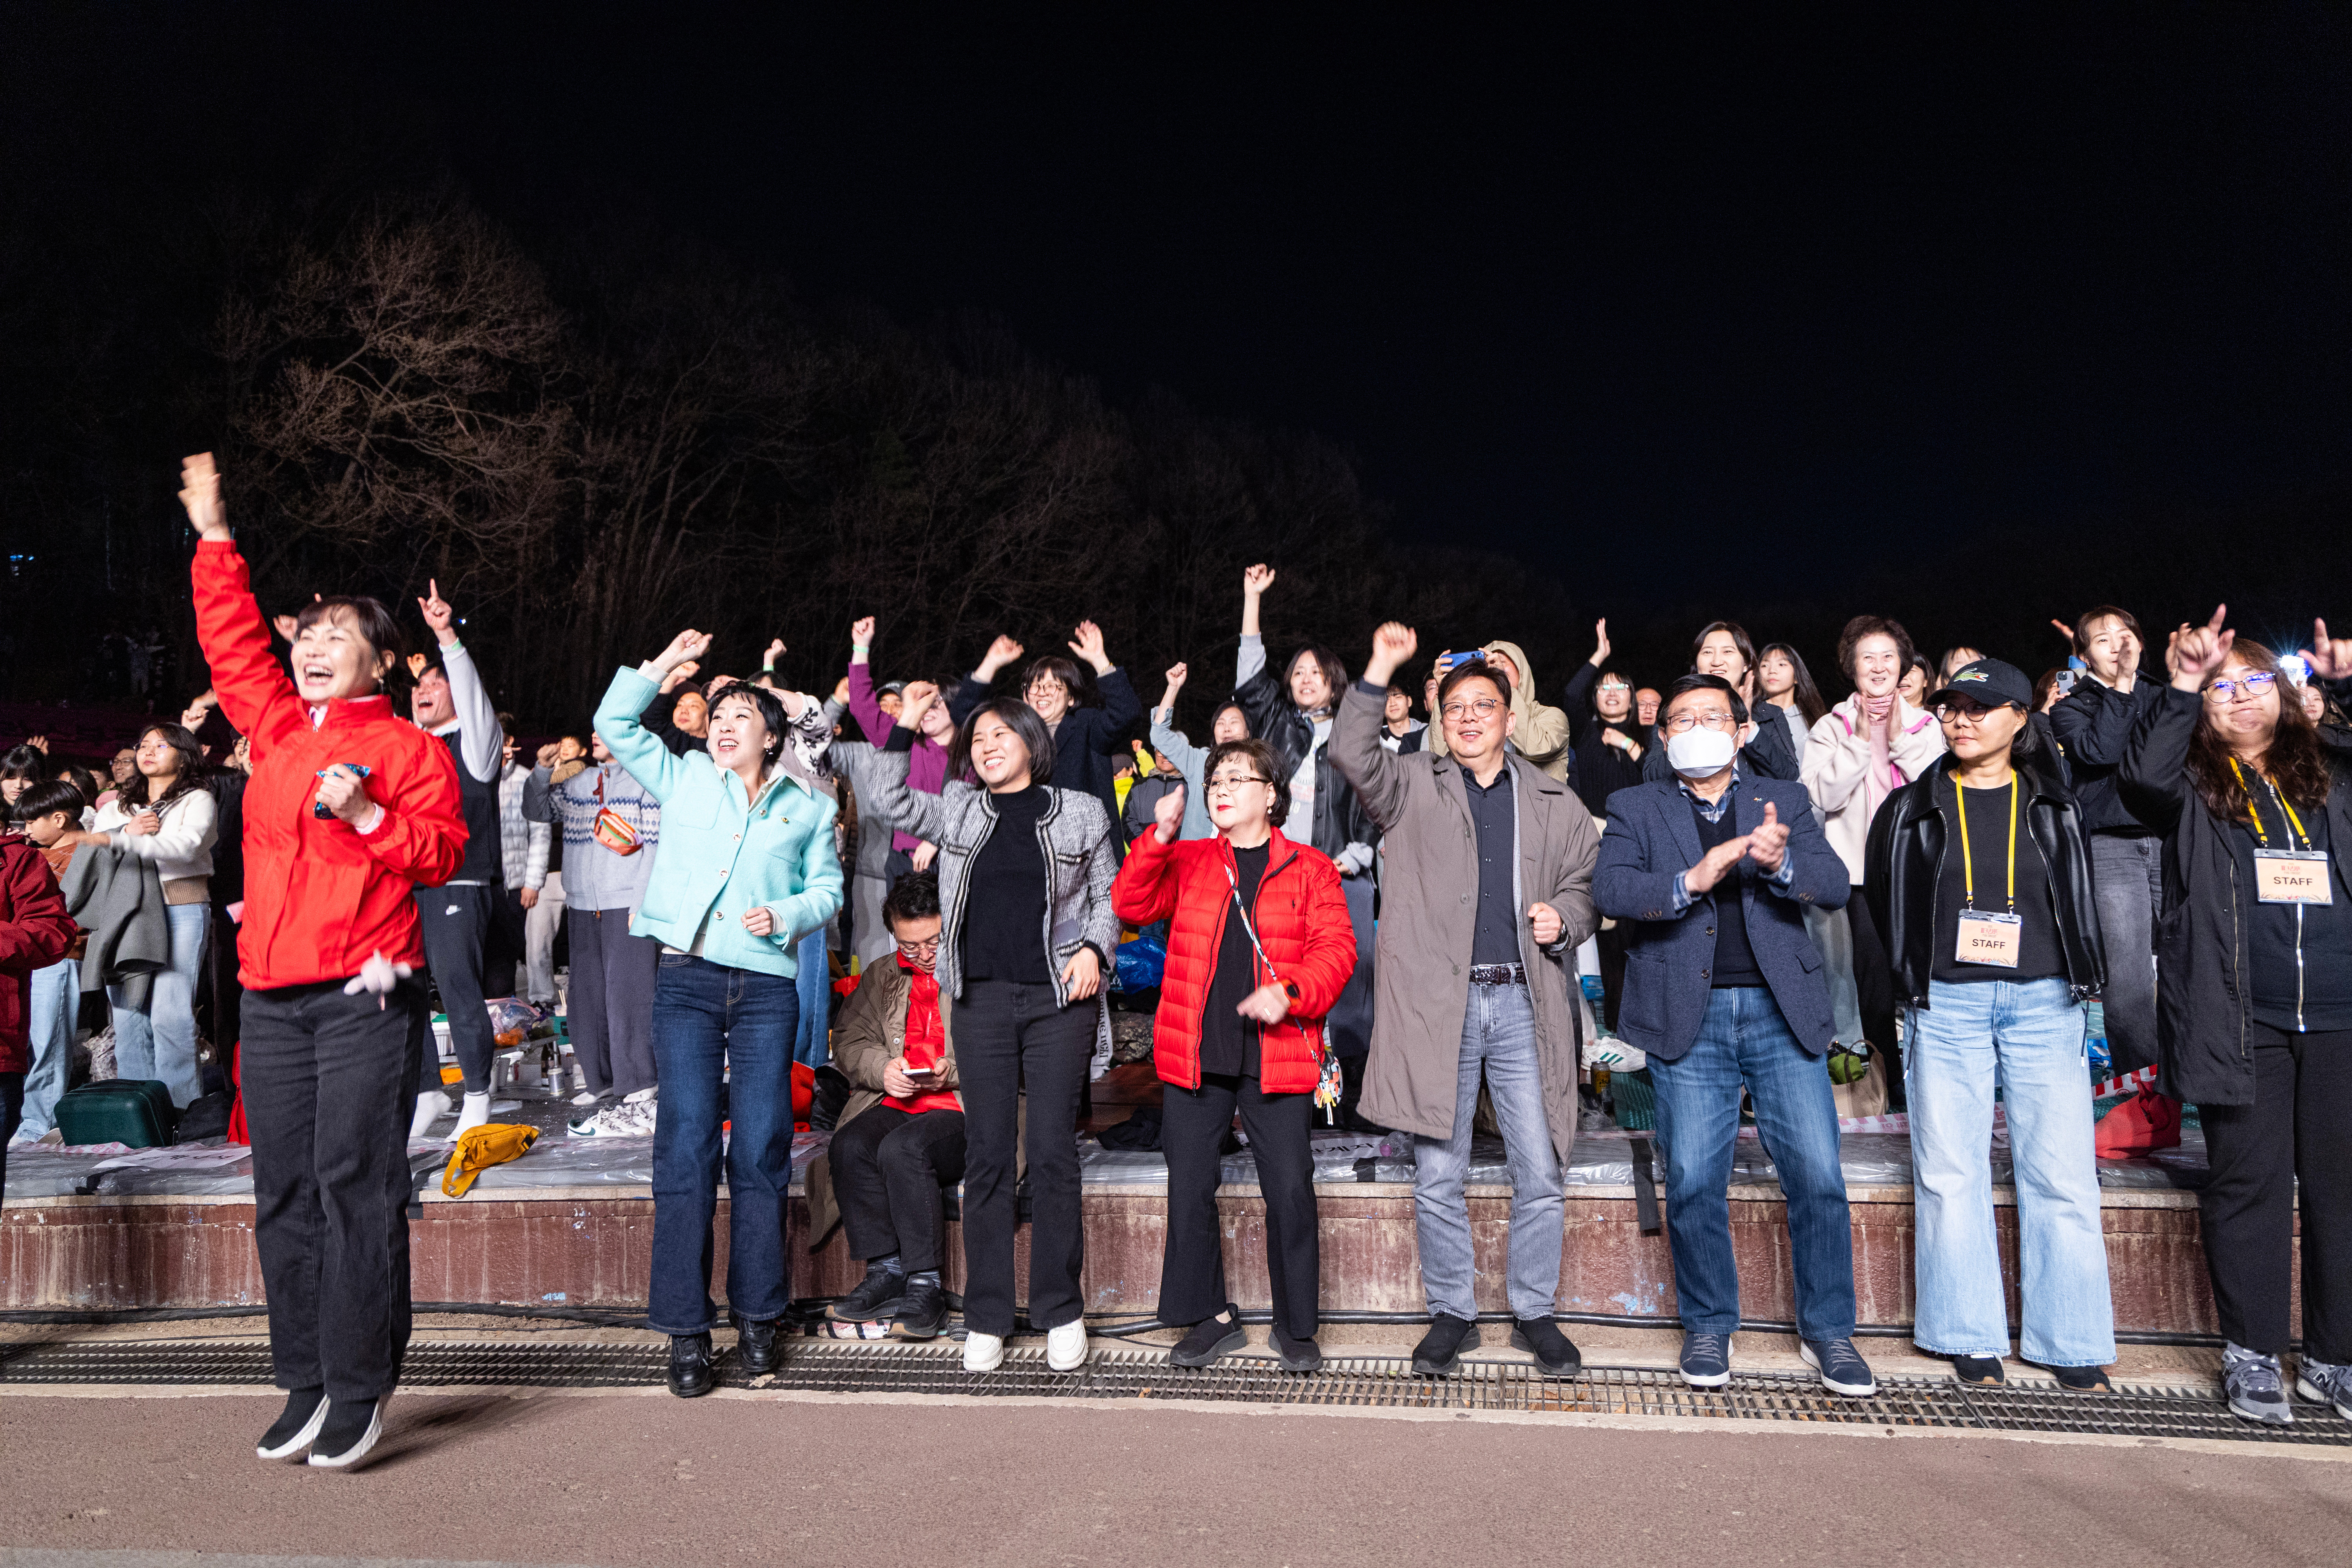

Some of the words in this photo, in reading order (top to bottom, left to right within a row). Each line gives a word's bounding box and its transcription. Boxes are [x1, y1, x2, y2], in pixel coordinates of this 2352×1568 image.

[2274, 877, 2312, 886] STAFF
[1972, 939, 2005, 949] STAFF
[1311, 1143, 1380, 1154] 계자
